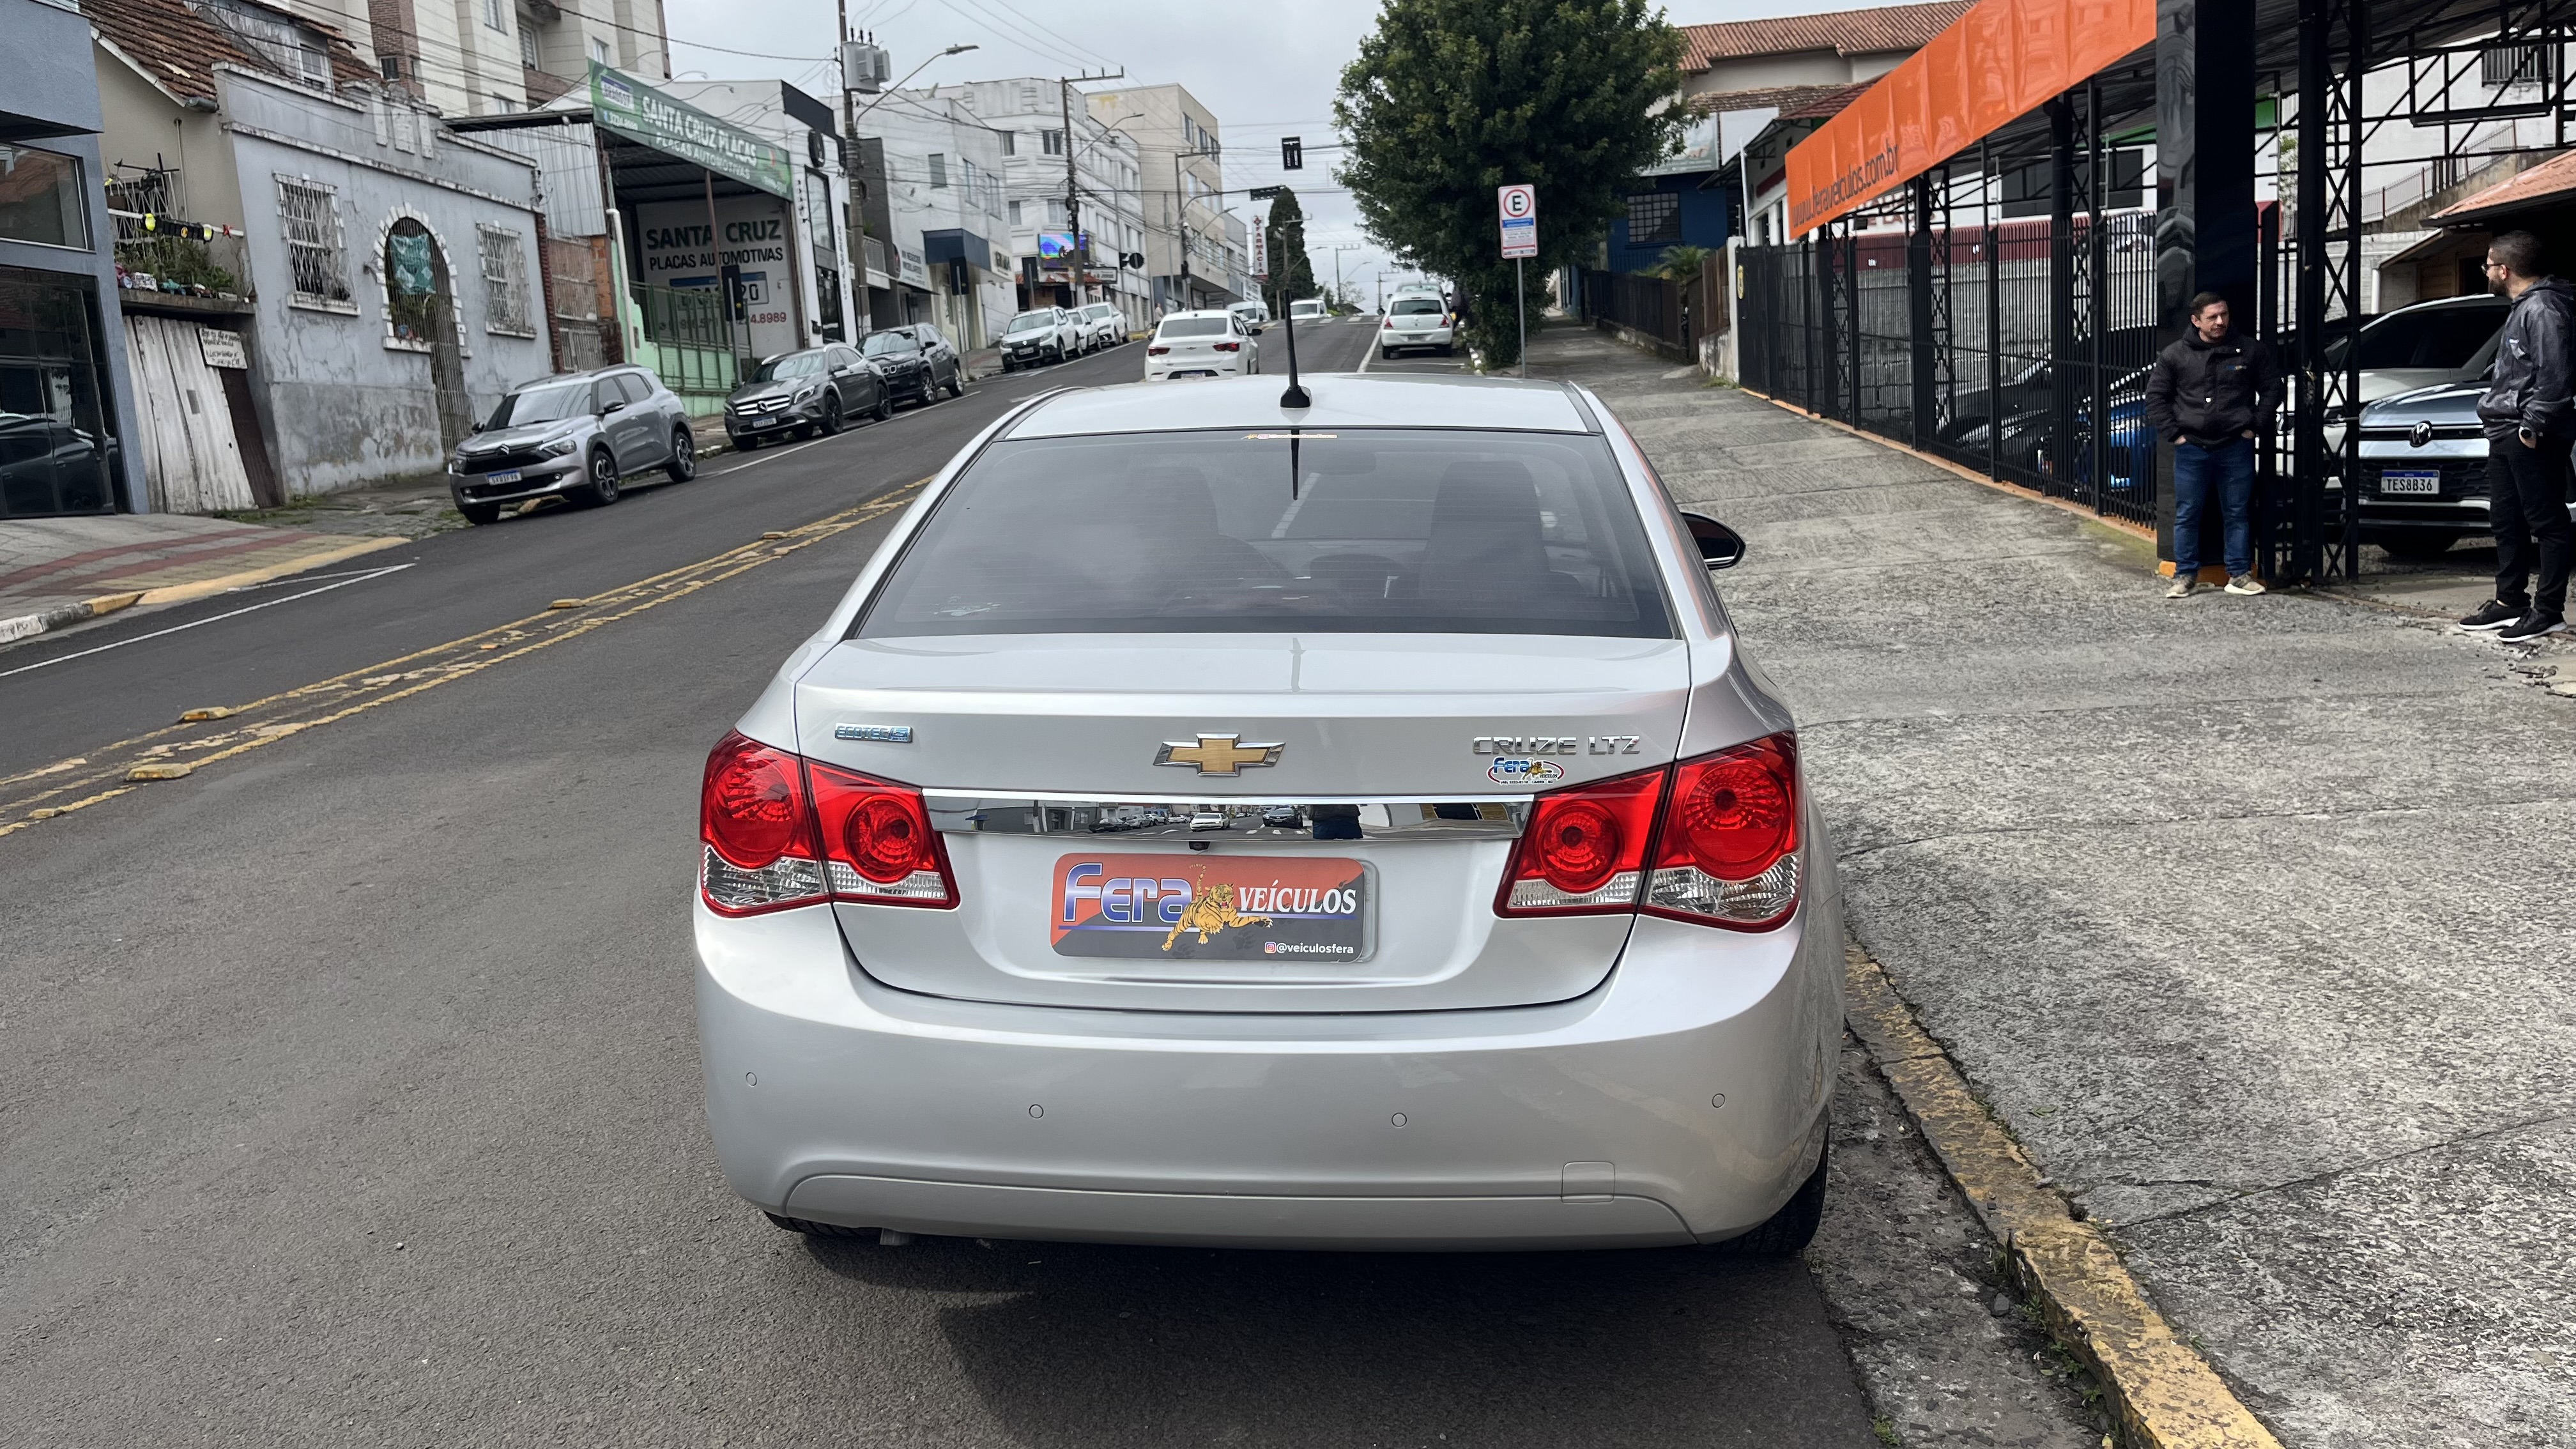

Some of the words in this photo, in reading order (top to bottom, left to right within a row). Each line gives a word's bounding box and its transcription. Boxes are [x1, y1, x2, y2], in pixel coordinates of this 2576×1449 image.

[642, 95, 684, 136] SANTA
[685, 115, 717, 150] CRUZ
[718, 130, 757, 167] PLACAS
[656, 132, 692, 156] PLACAS
[693, 148, 750, 180] AUTOMOTIVAS
[1792, 138, 1899, 228] www.feraveiculos.com.br
[1512, 195, 1522, 211] E
[646, 224, 714, 250] SANTA
[725, 219, 781, 243] CRUZ
[1255, 226, 1264, 273] FARMACIA
[650, 255, 696, 271] PLACAS
[2387, 479, 2432, 491] TES8B36
[1473, 737, 1577, 755] CRUZE
[1589, 735, 1640, 755] LTZ
[1494, 758, 1529, 773] Fera
[1063, 862, 1193, 923] Fera
[1238, 880, 1356, 914] VEÍCULOS
[1276, 942, 1354, 954] @veiculosfera
